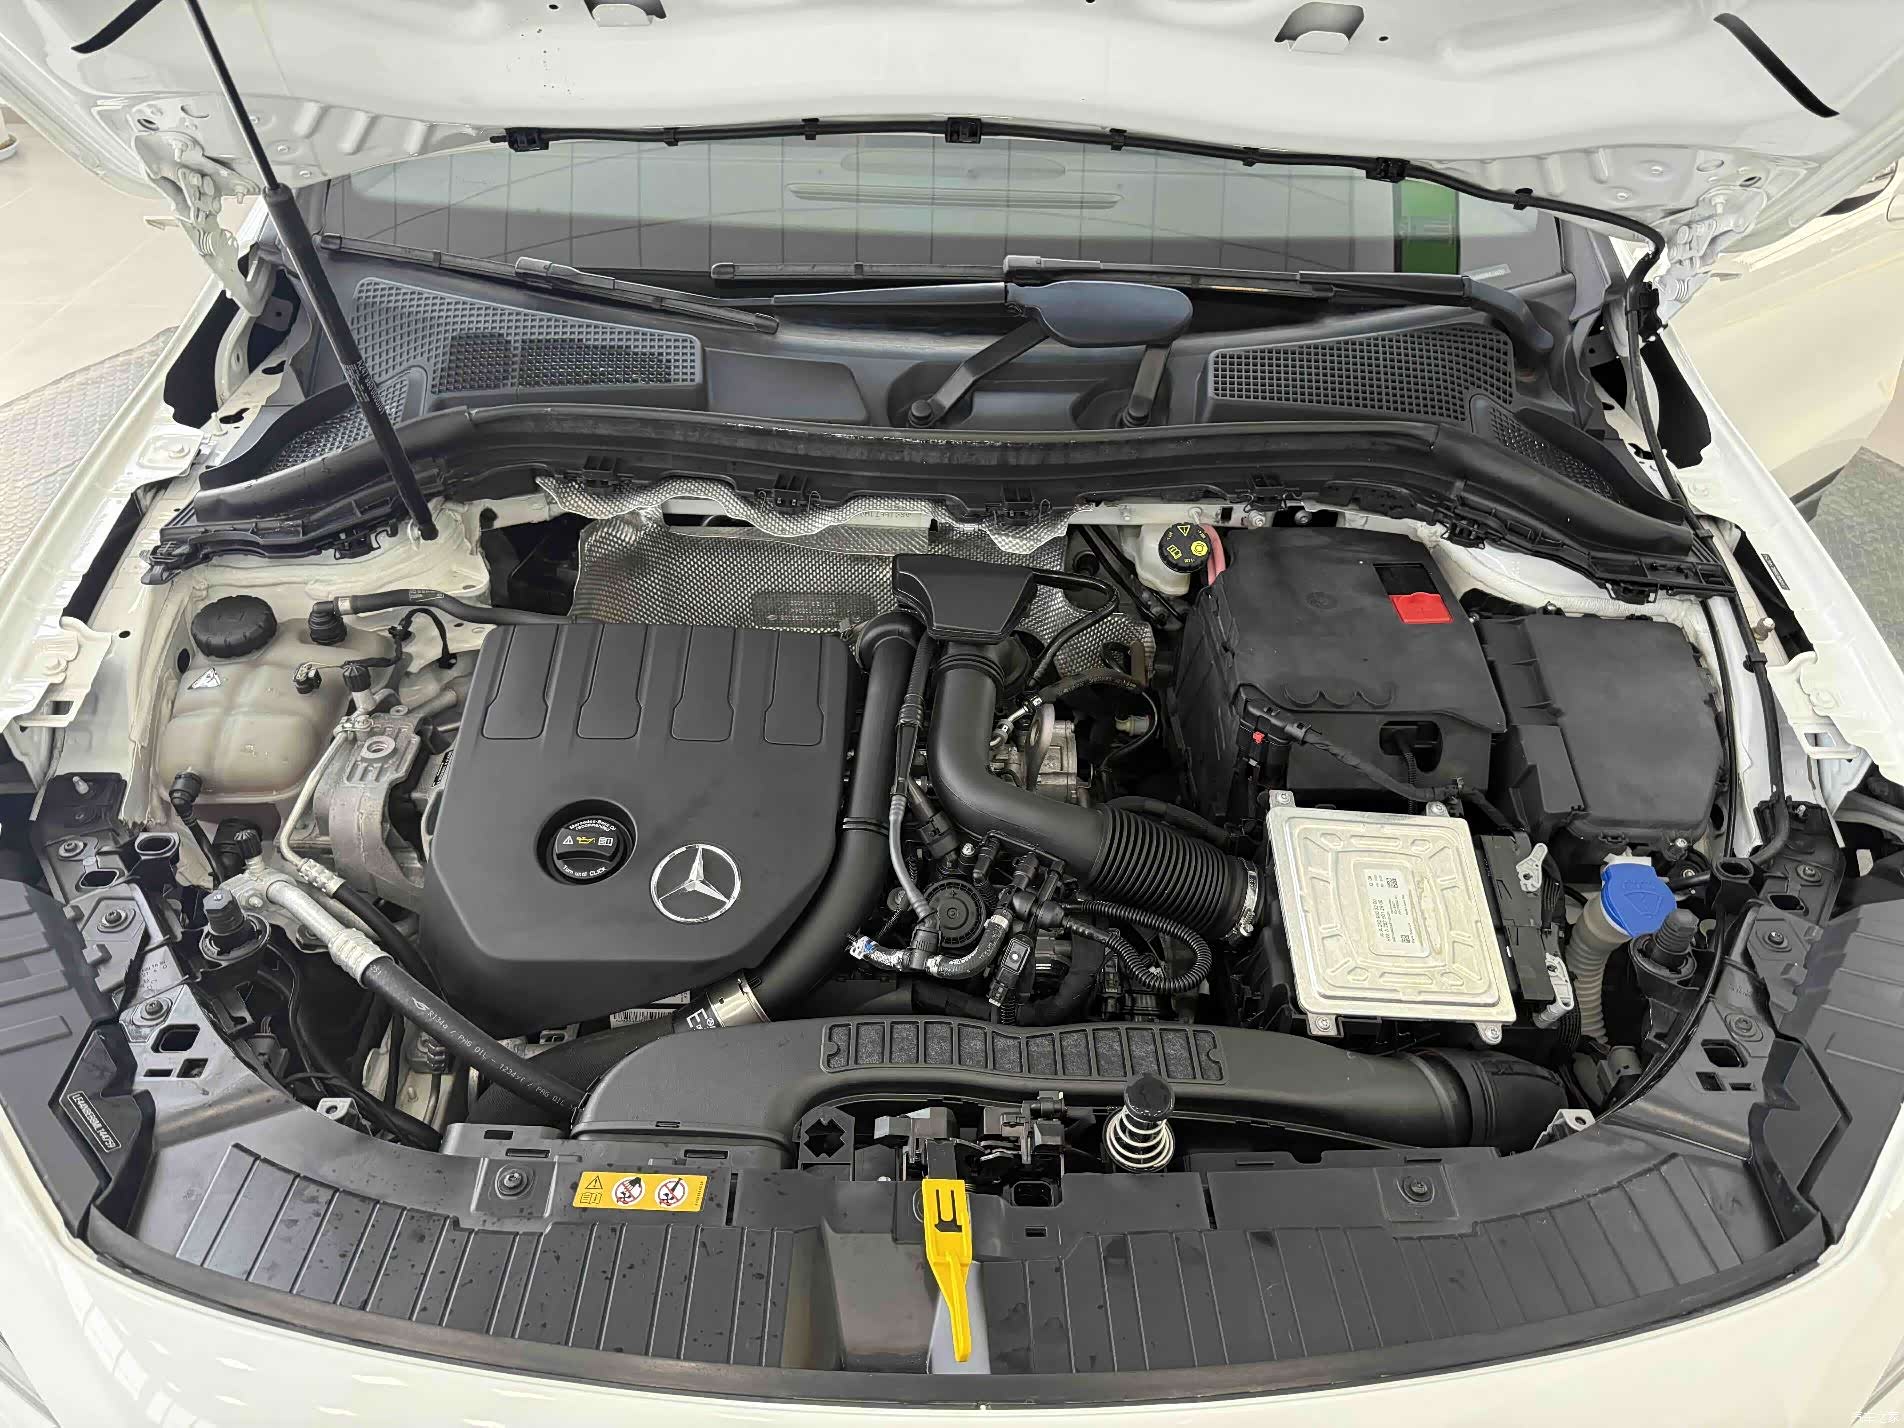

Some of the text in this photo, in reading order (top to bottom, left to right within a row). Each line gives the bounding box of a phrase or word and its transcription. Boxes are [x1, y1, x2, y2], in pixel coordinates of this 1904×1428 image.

[562, 865, 574, 874] Turn
[589, 867, 607, 876] CLICK
[428, 1010, 449, 1029] R134a
[474, 1046, 487, 1060] OIL
